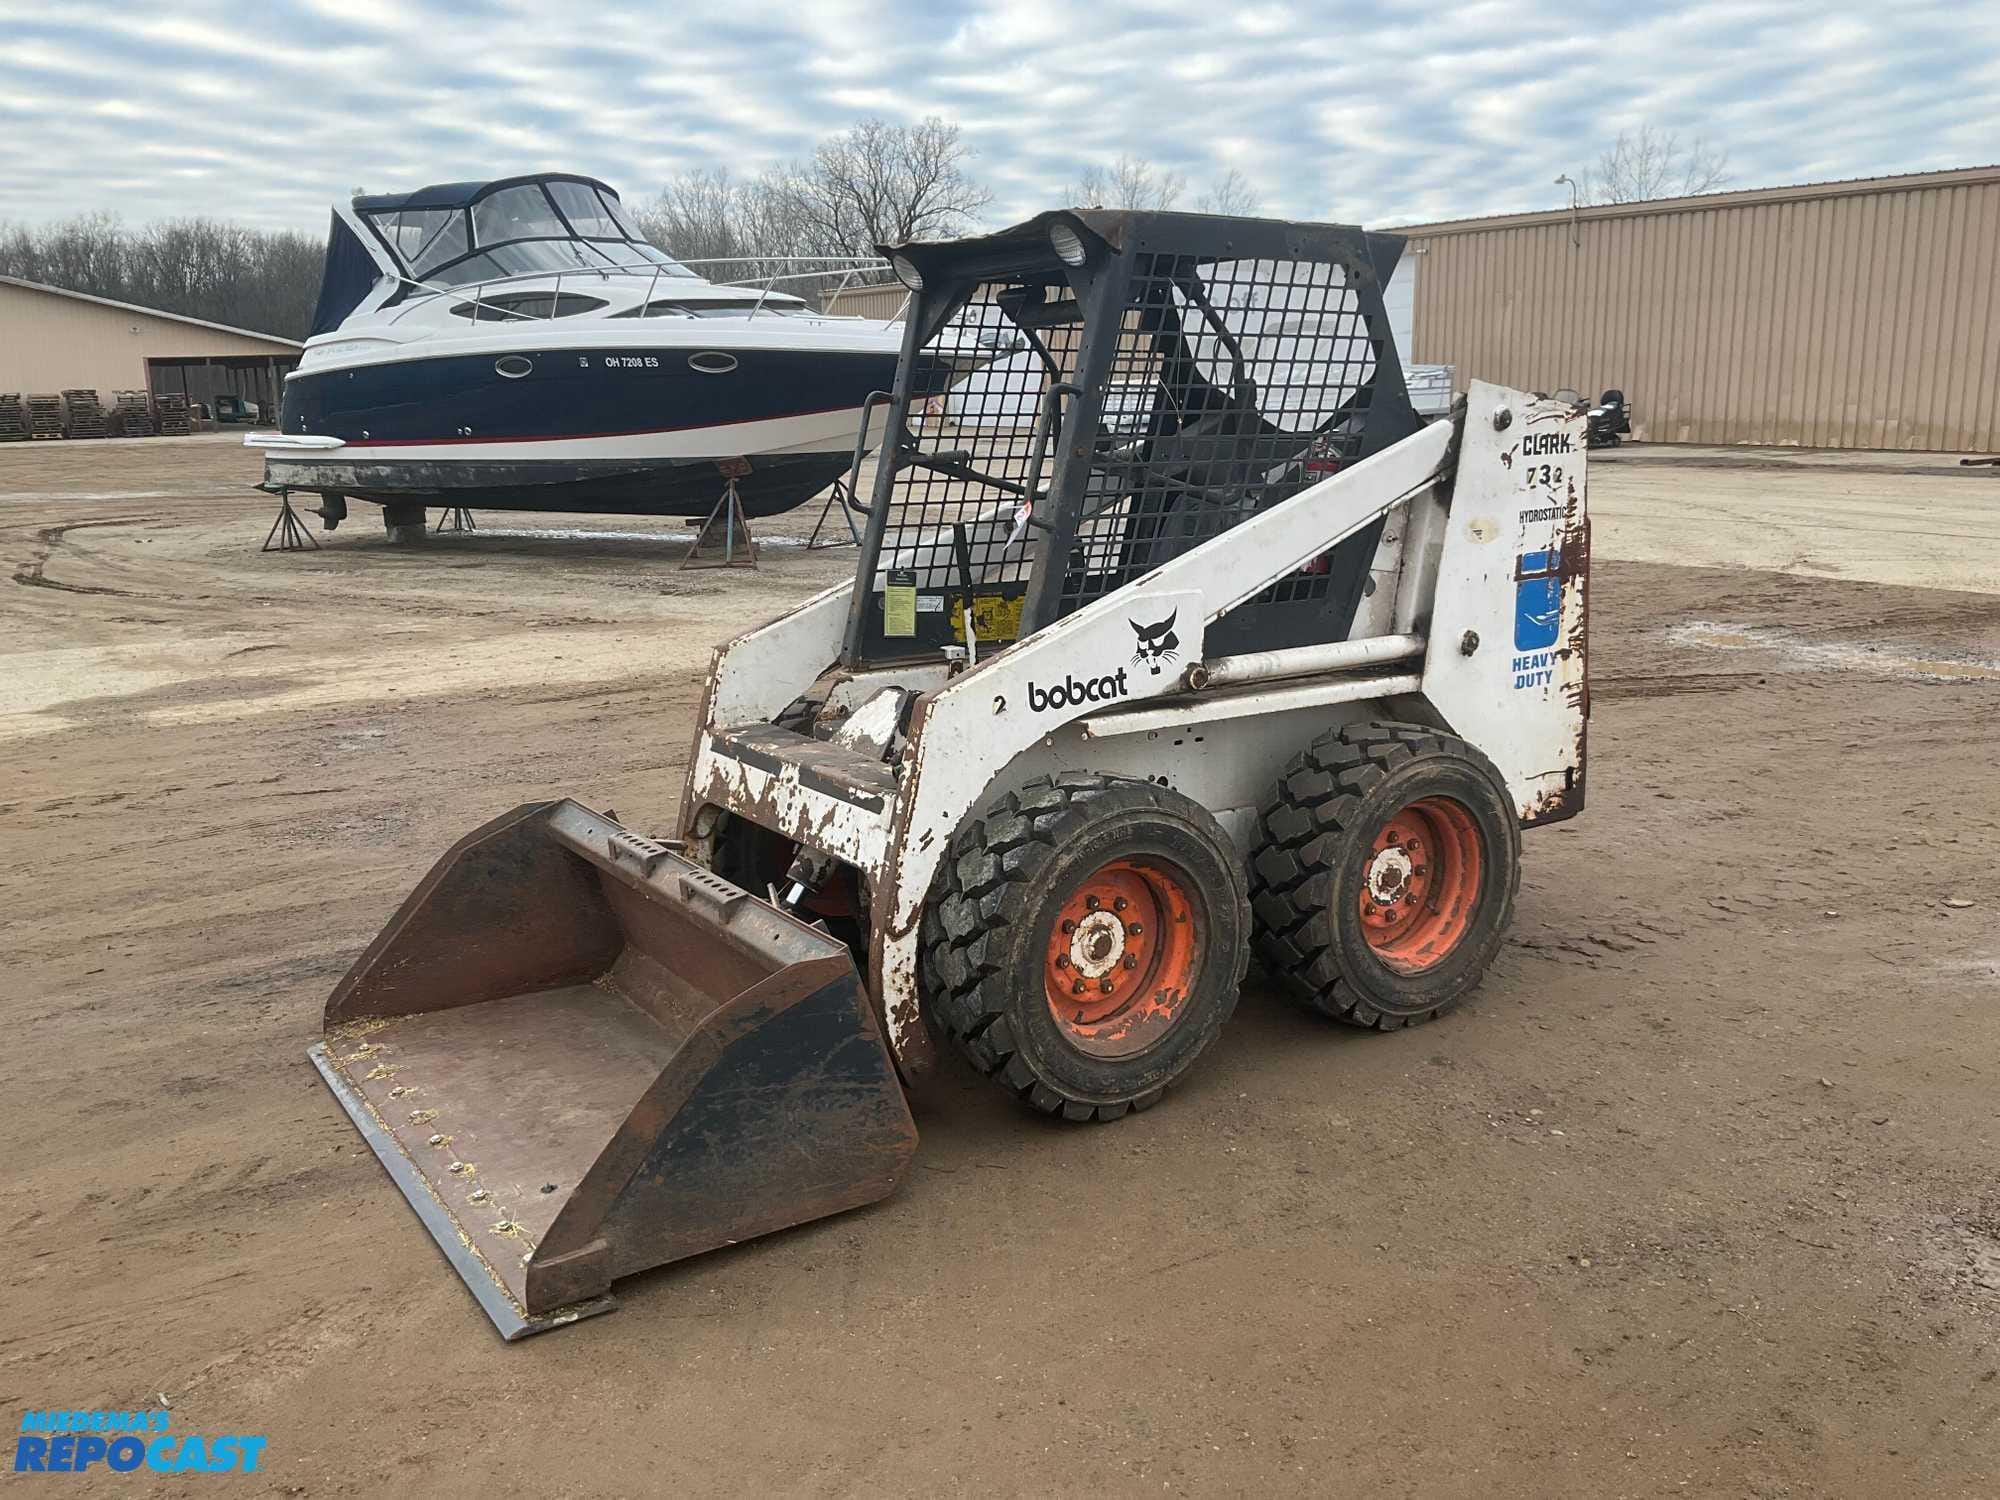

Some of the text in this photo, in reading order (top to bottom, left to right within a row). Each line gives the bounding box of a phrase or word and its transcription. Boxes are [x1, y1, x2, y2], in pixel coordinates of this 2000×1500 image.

[605, 357, 659, 368] OH 7208 ES
[1522, 432, 1571, 456] CLARK
[1526, 464, 1563, 485] 732
[1519, 506, 1567, 524] HYDROSTATIC
[1512, 652, 1558, 672] HEAVY
[1028, 667, 1128, 713] bobcat
[1514, 670, 1553, 690] DUTY
